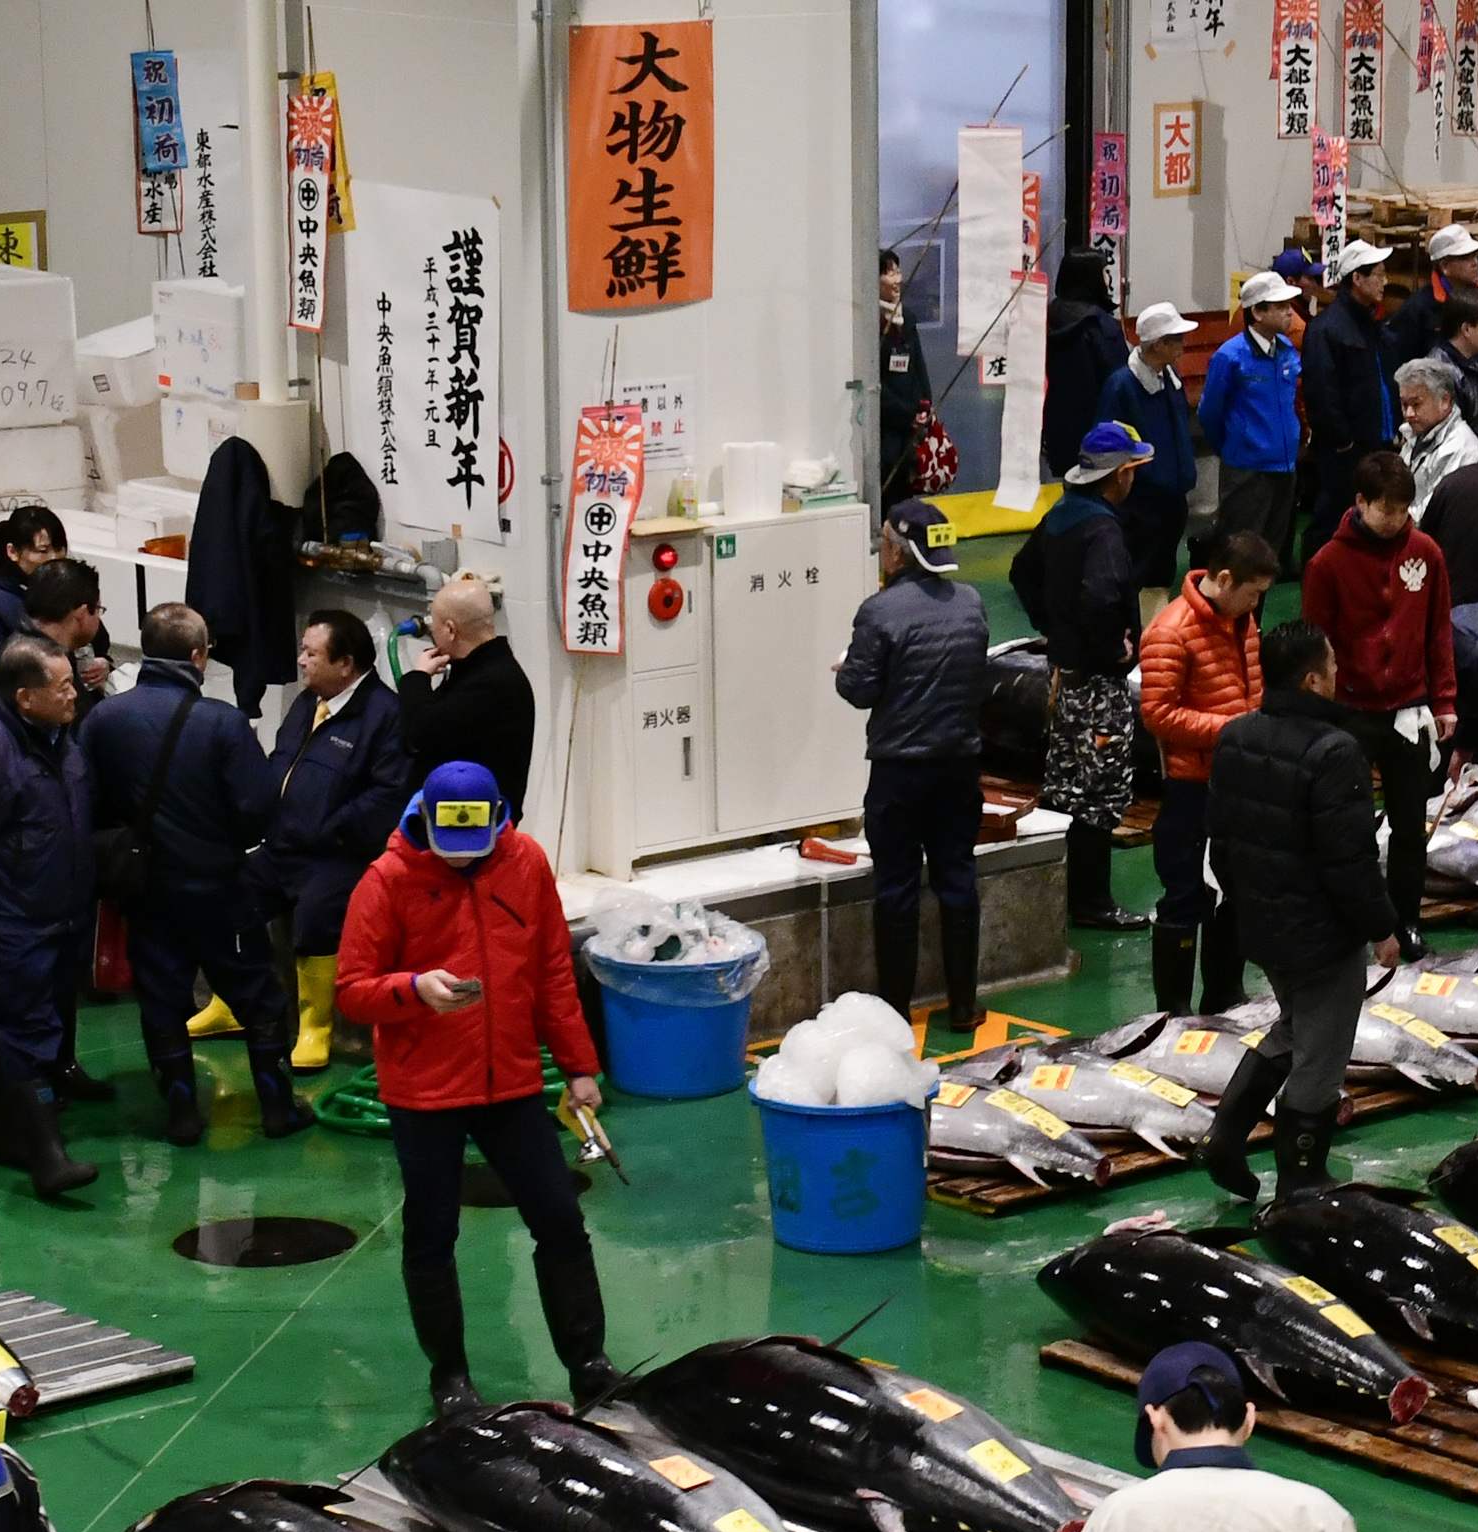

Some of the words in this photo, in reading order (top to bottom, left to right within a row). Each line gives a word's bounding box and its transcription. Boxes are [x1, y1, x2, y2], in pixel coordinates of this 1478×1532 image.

[1204, 0, 1225, 38] 年
[143, 60, 180, 164] 祝初荷
[1284, 44, 1312, 135] 大都魚類
[1349, 52, 1377, 140] 大都魚類
[1456, 46, 1476, 132] 大都魚類
[603, 31, 689, 300] 大物生鮮
[1100, 141, 1121, 231] 祝初荷
[1164, 115, 1191, 185] 大都
[194, 128, 219, 278] 東都水産株式会社
[297, 216, 319, 324] 中央魚類
[375, 292, 399, 485] 中央魚類株式会社
[423, 256, 441, 449] 平成三十一年元旦
[443, 227, 486, 511] 謹賀新年
[585, 465, 628, 497] 初荷
[576, 540, 613, 646] 中央魚類
[749, 567, 821, 593] 消火栓
[642, 705, 691, 731] 消火器
